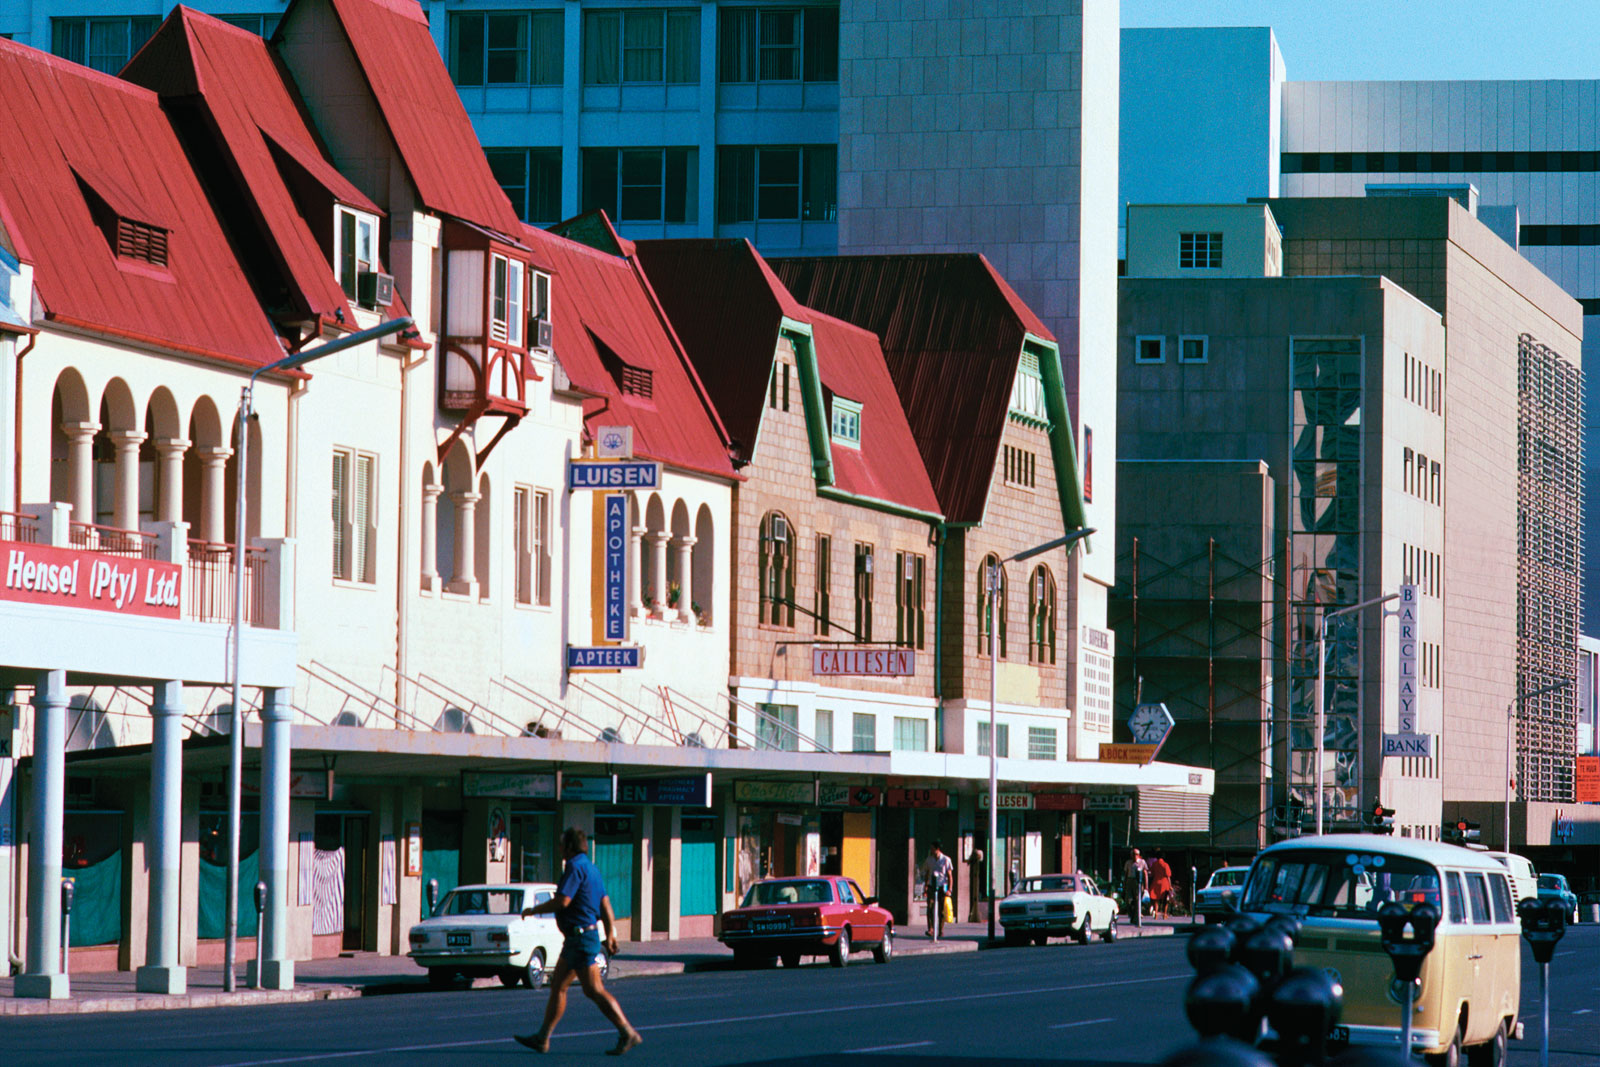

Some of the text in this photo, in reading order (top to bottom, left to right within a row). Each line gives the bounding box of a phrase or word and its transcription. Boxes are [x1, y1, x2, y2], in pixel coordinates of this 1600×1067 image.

[573, 468, 653, 485] LUISEN
[609, 502, 622, 634] APOTHEKE
[6, 550, 179, 609] Hensel (Pty) Ltd.
[575, 651, 631, 665] APTEEK
[821, 652, 907, 673] CALLESEN
[1402, 589, 1413, 731] BARCLAYS
[1387, 739, 1426, 752] BANK
[983, 795, 1028, 807] CLLESEN
